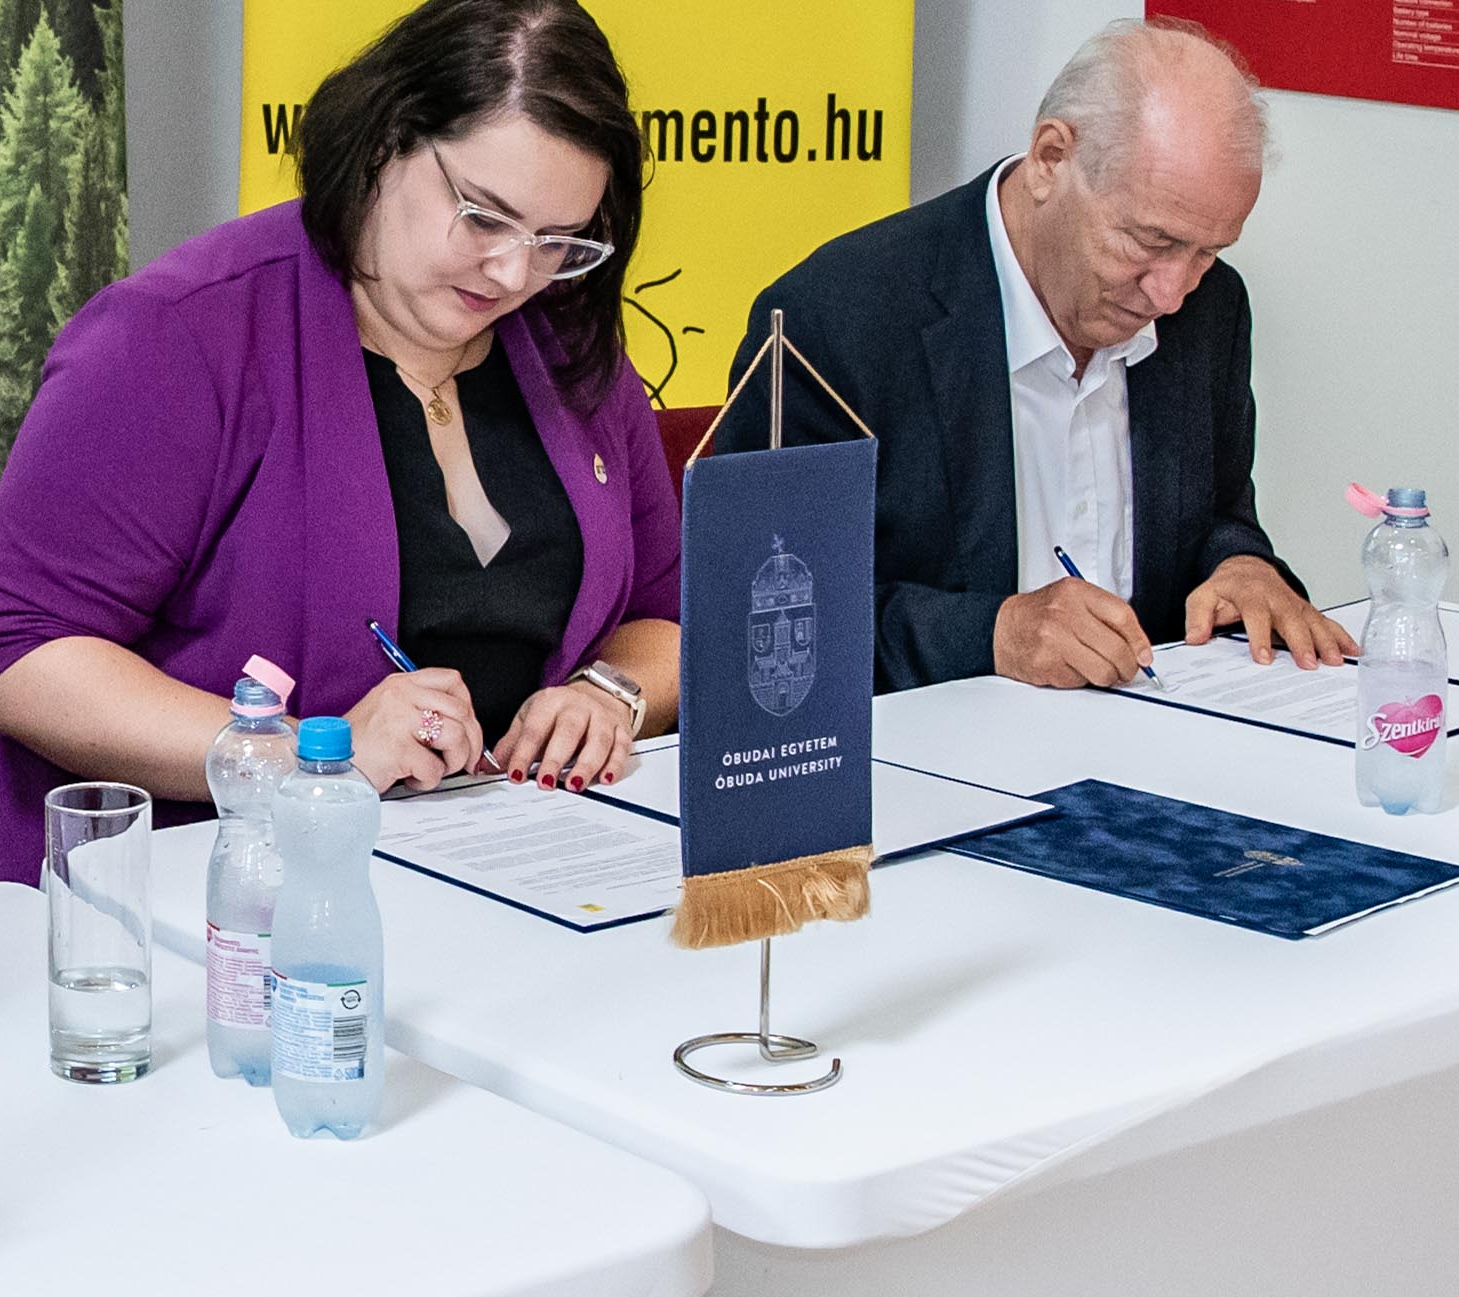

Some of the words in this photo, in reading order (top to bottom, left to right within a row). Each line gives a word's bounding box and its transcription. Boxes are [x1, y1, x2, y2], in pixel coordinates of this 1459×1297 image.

[722, 748, 776, 767] ÓBUDAI
[780, 735, 838, 759] EGYETEM
[714, 770, 764, 791] ÓBUDA
[768, 755, 843, 784] UNIVERSITY
